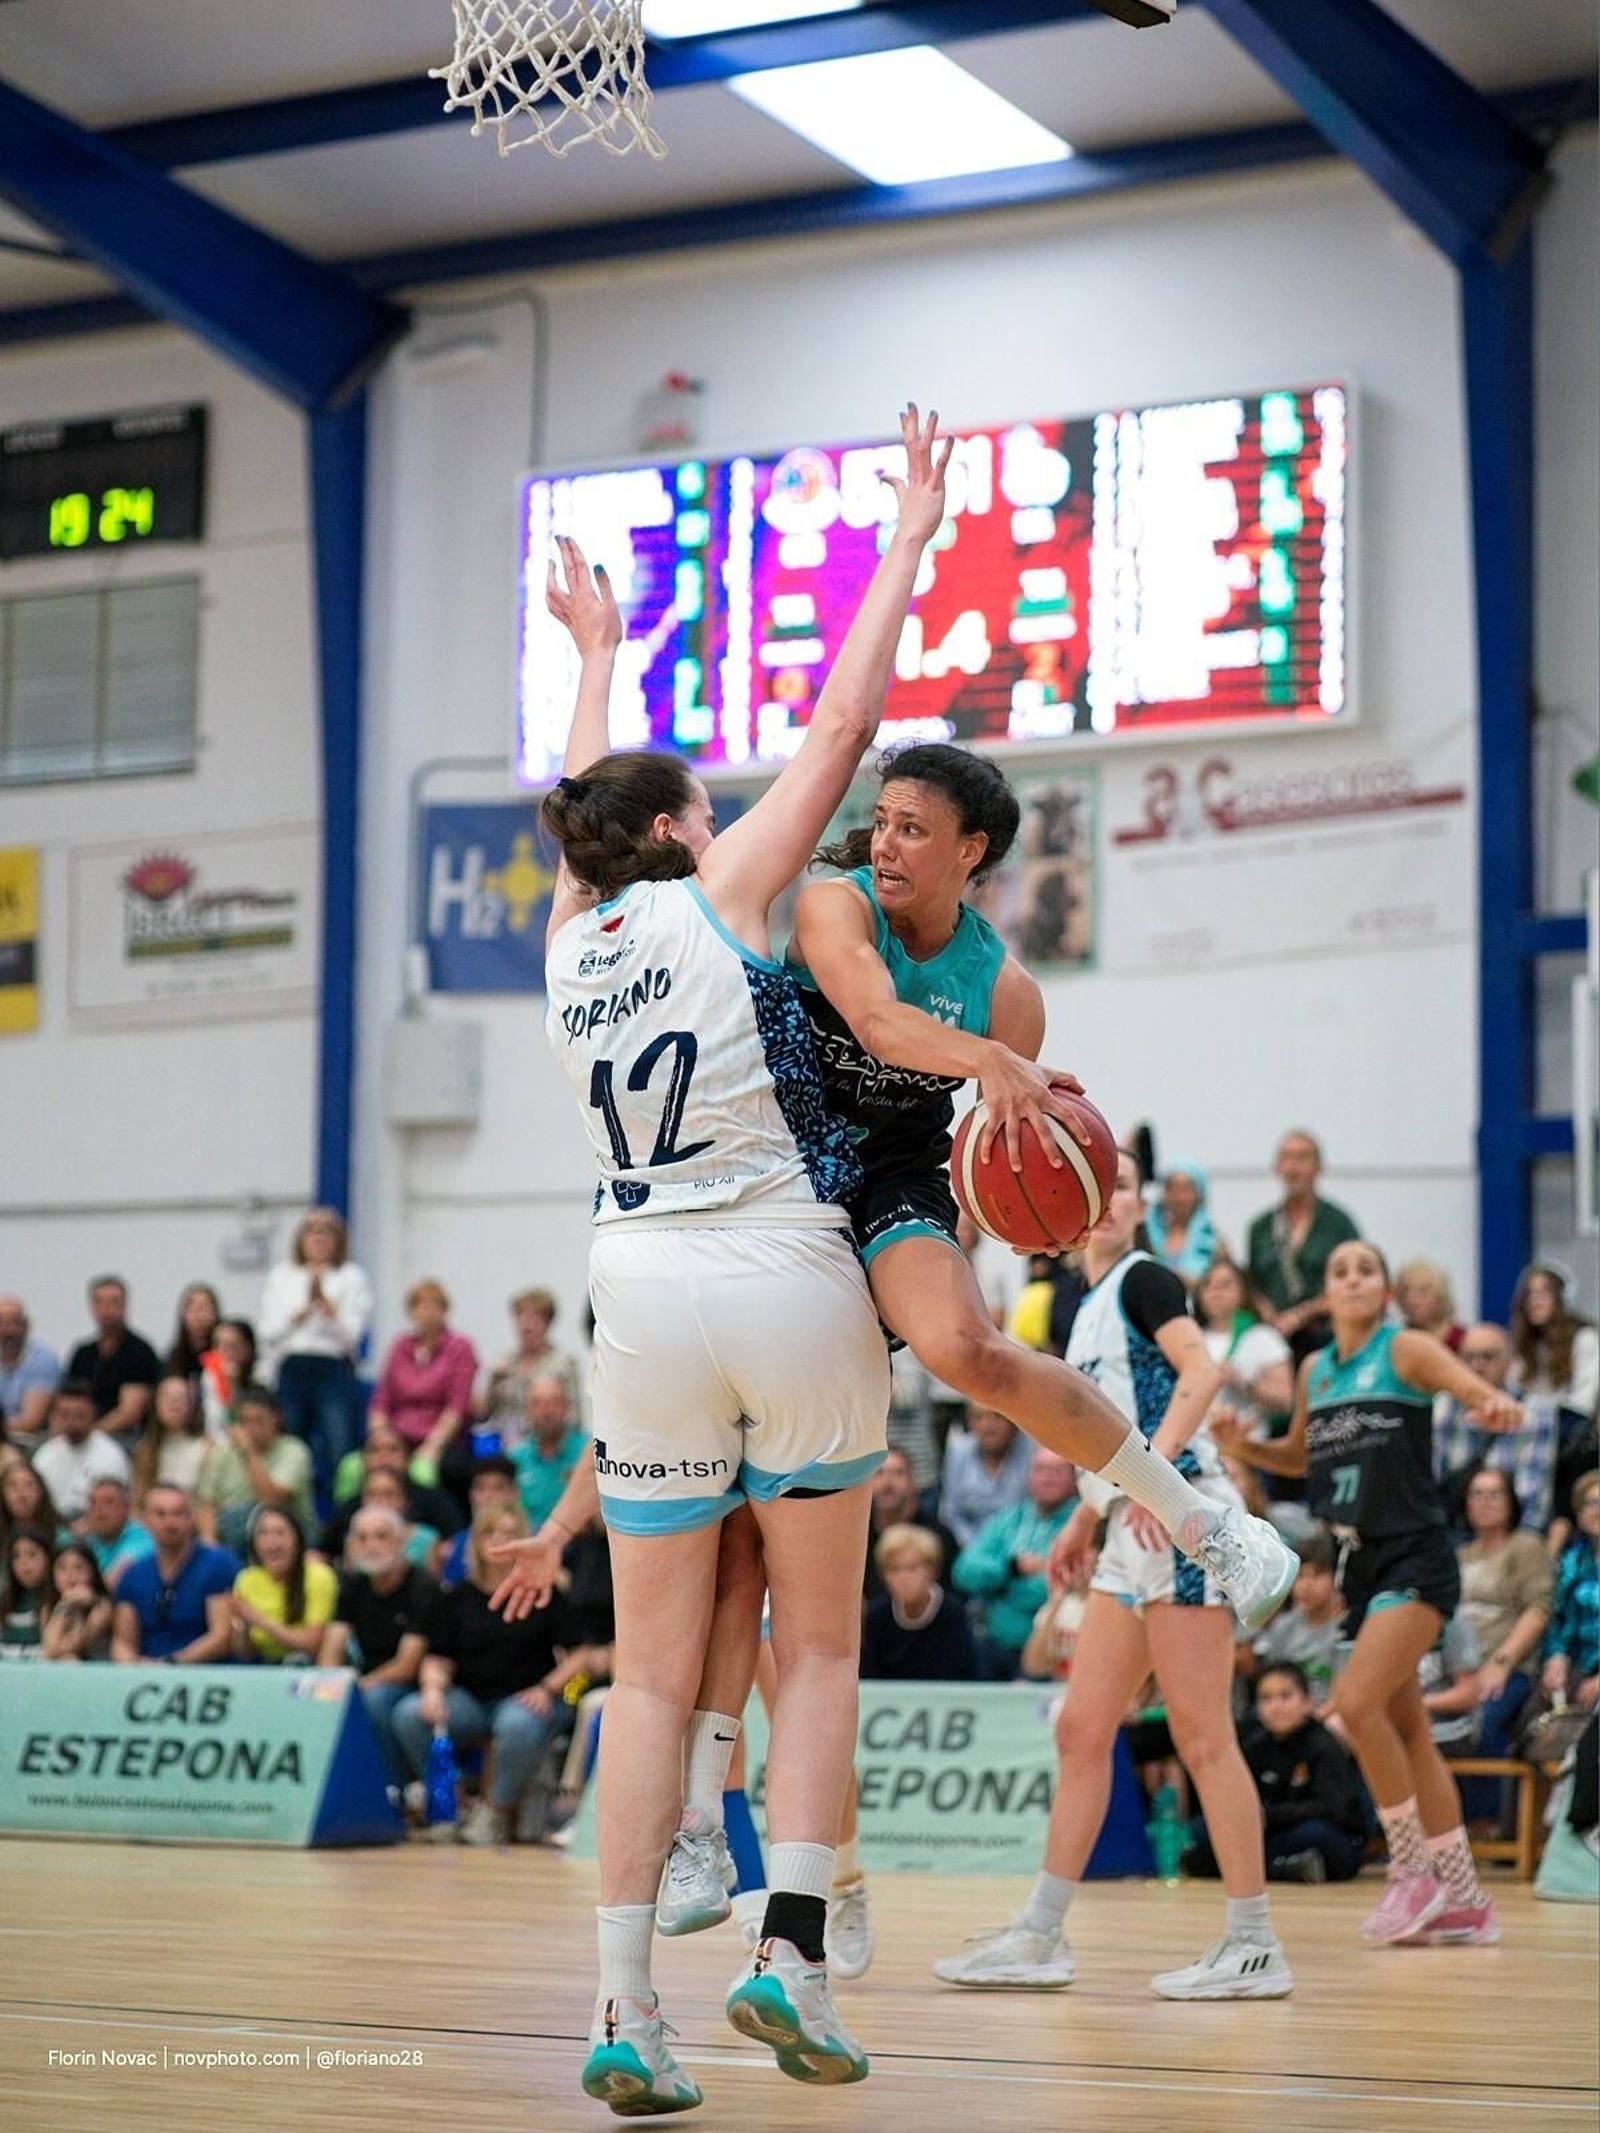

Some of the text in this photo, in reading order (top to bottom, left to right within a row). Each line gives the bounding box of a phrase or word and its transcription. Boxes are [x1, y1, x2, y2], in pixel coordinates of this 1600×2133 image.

[99, 487, 154, 543] 24
[562, 968, 672, 1045] SORIANO
[929, 994, 964, 1015] vive
[590, 1031, 716, 1171] 12
[123, 1682, 232, 1725] CAB
[862, 1707, 977, 1753] CAB
[18, 1734, 305, 1785] ESTEPONA
